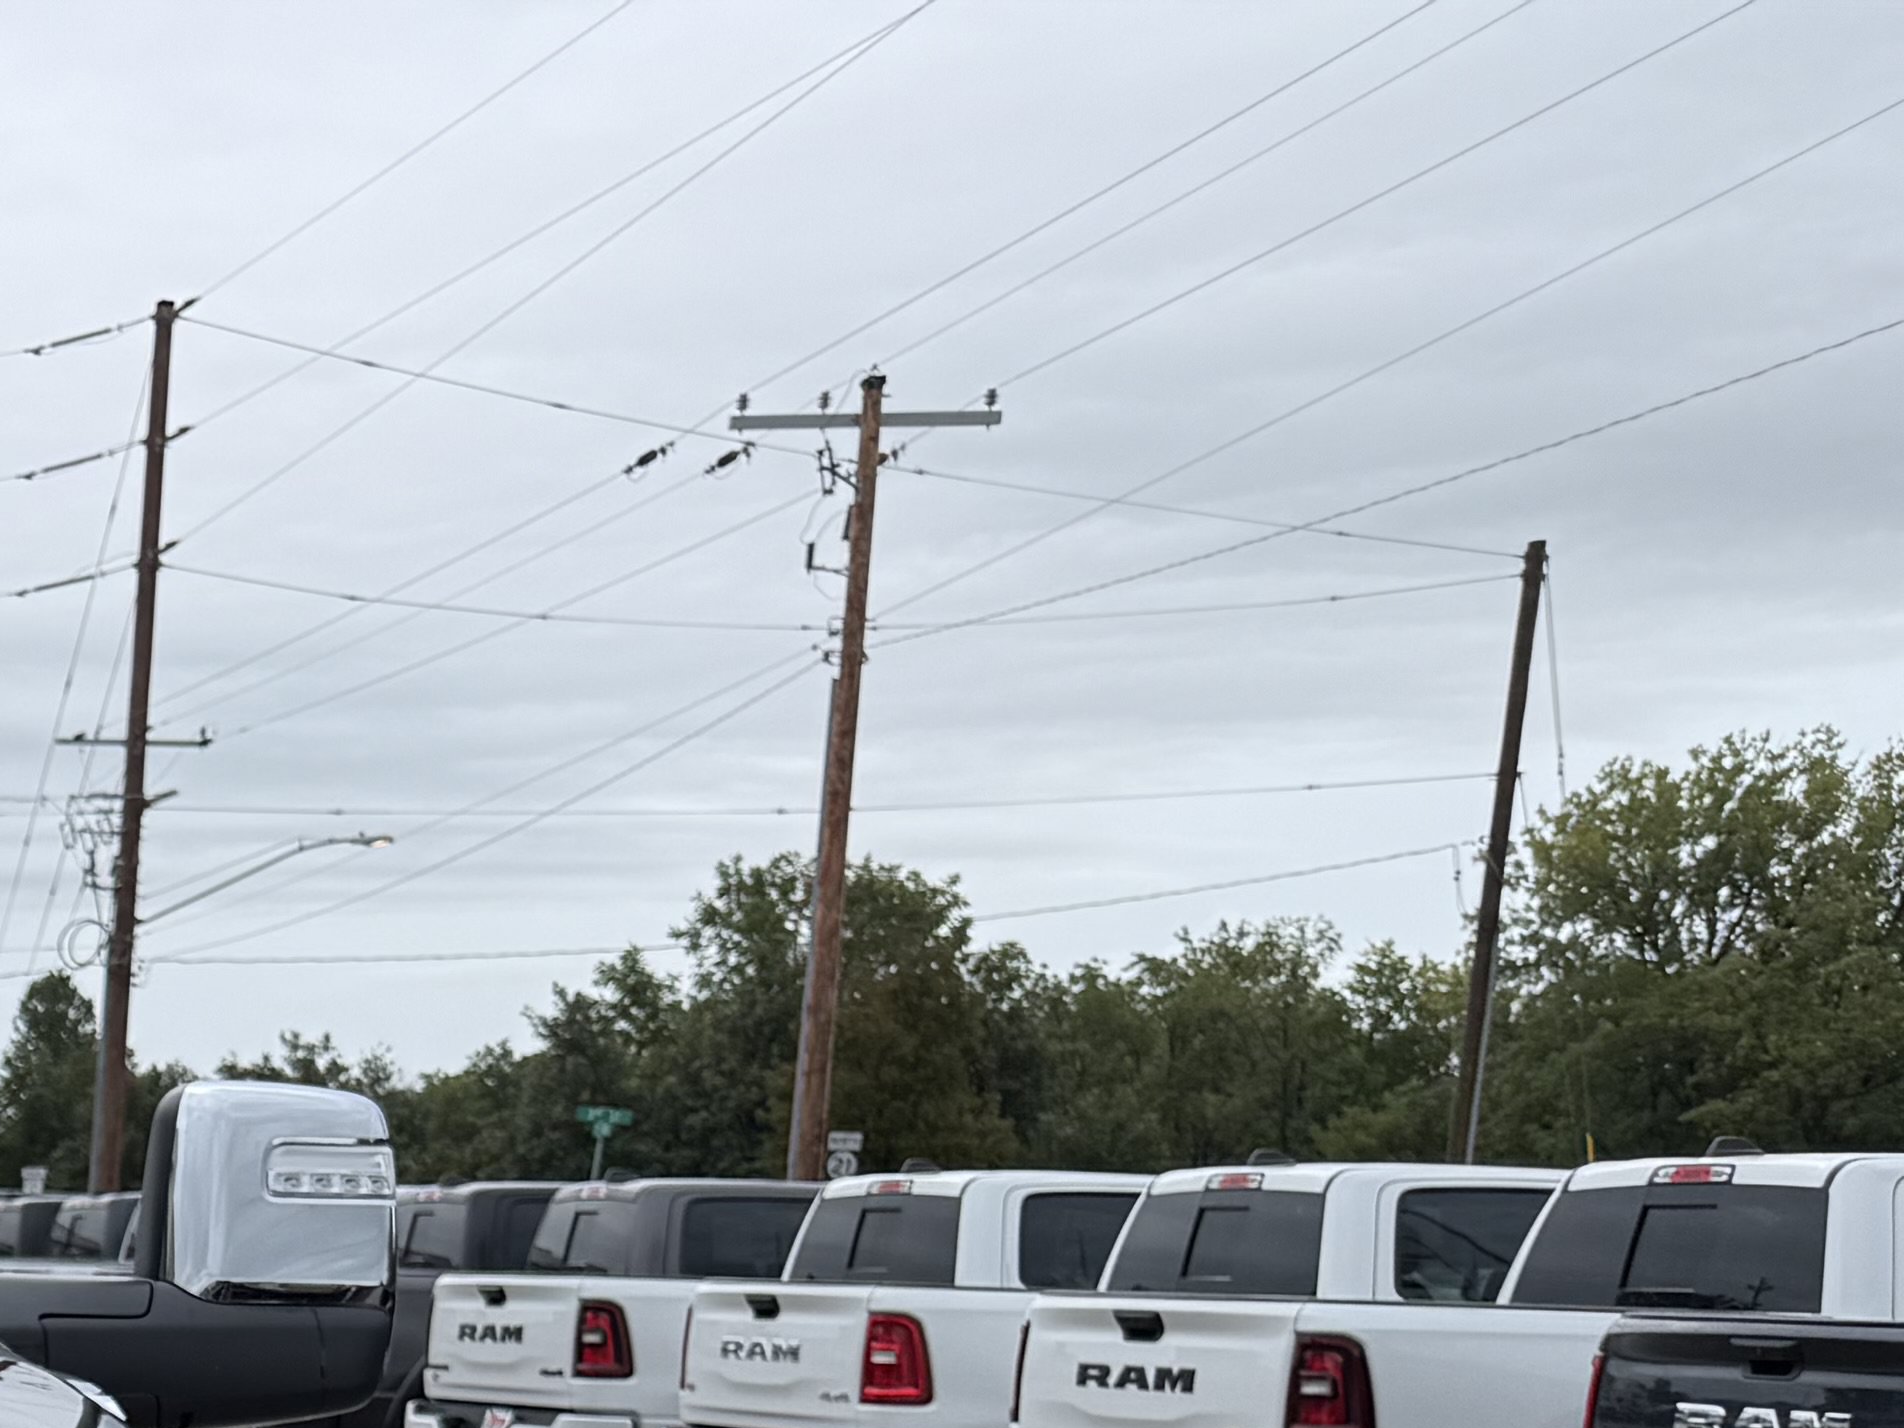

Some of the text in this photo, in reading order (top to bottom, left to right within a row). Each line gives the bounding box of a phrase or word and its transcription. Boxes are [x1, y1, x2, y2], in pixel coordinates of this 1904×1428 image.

[458, 1323, 524, 1343] RAM
[720, 1337, 801, 1363] RAM
[1076, 1363, 1196, 1395] RAM
